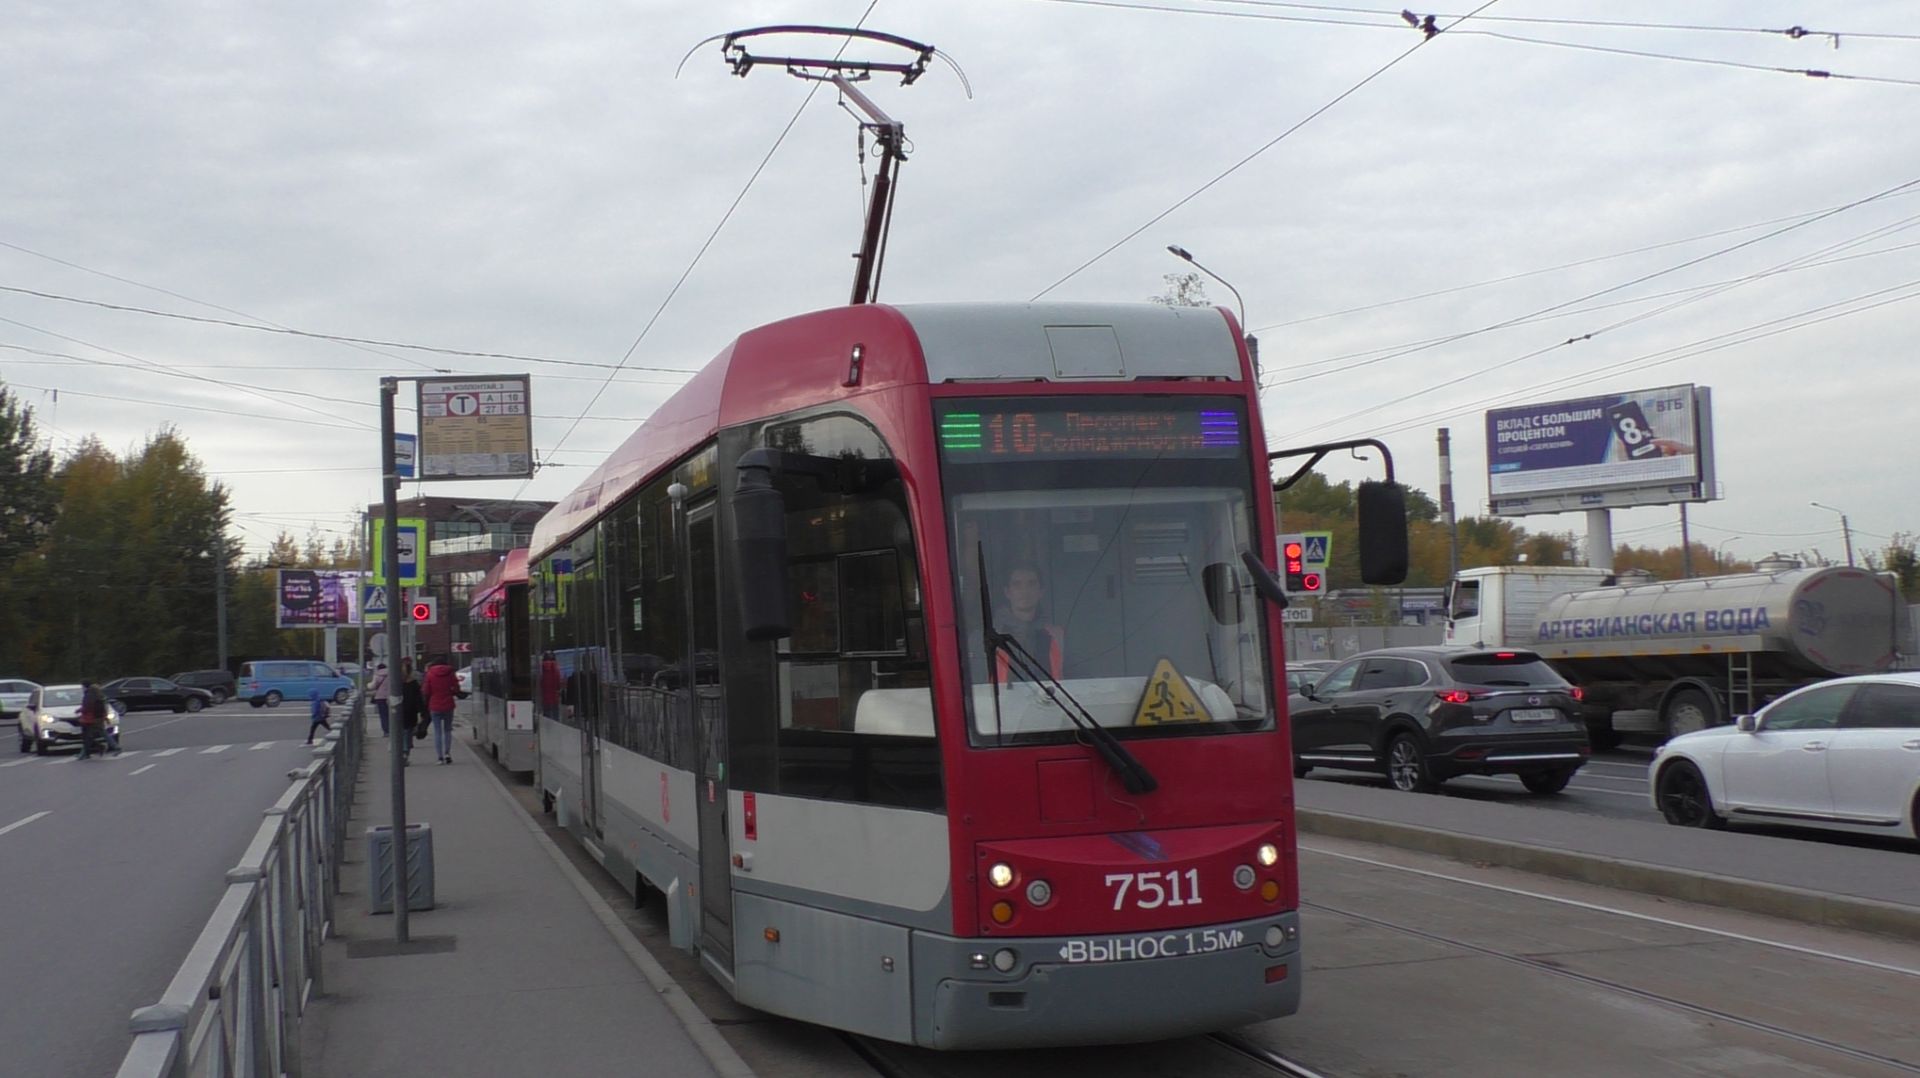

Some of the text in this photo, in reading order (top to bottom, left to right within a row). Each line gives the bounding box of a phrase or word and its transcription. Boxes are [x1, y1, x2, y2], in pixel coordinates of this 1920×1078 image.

[455, 396, 469, 413] Т
[1656, 399, 1683, 412] ВТБ
[1066, 412, 1175, 432] Проспект
[1497, 417, 1530, 430] ВКЛАД
[1532, 416, 1540, 426] С
[1542, 408, 1602, 425] БОЛЬШИМ
[989, 413, 1037, 453] 10
[1498, 426, 1565, 442] ПРОЦЕНТОМ
[1282, 610, 1308, 620] ТОП
[1538, 607, 1770, 640] АРТЕЗИАНСКАЯ ВОДА
[1104, 868, 1203, 911] 7511
[1068, 929, 1238, 962] ВЫНОС 1.5М
